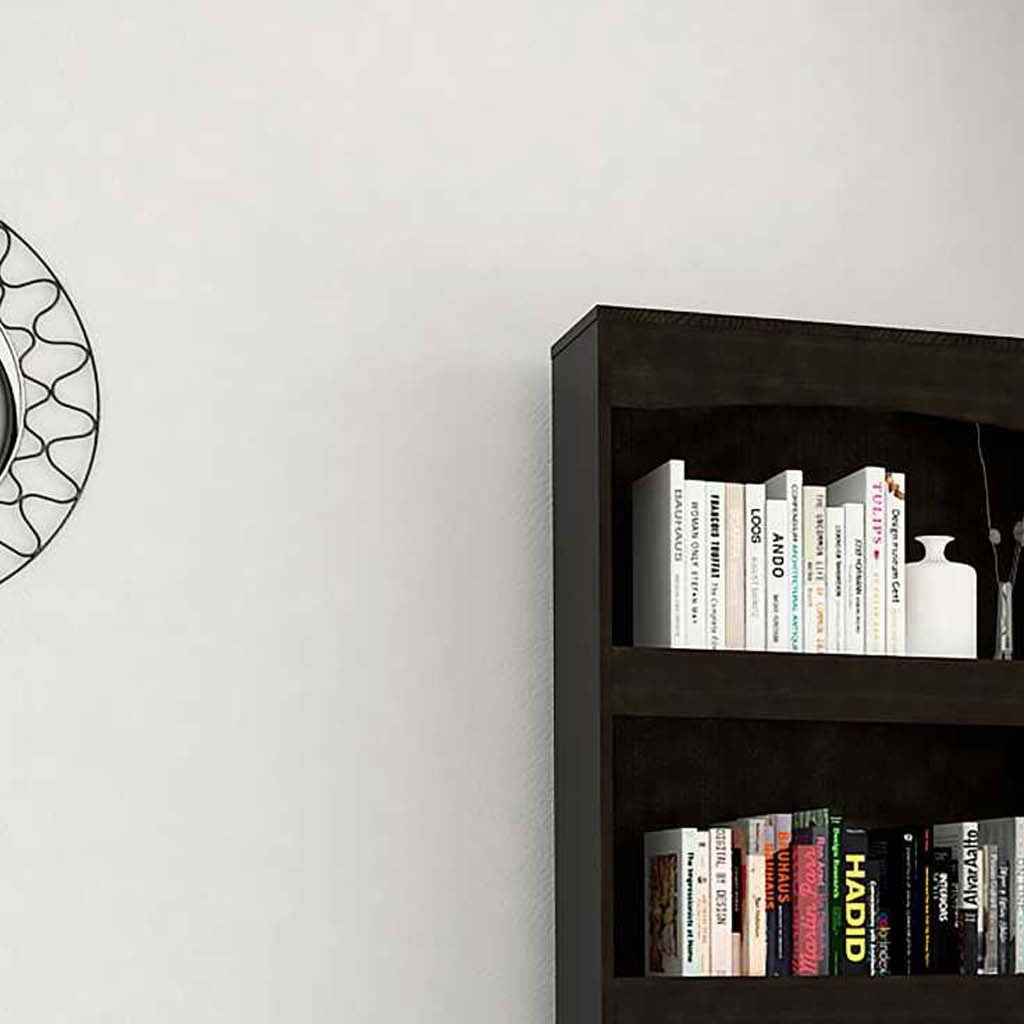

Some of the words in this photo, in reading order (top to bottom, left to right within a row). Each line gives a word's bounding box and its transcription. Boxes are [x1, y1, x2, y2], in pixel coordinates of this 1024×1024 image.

[674, 489, 684, 562] BAUHAUS
[691, 502, 700, 539] WOMAN
[751, 508, 762, 544] LOOS
[871, 483, 882, 545] TULIPS
[889, 509, 901, 541] Design
[690, 541, 700, 567] ONLY
[772, 532, 785, 579] ANDO
[686, 852, 695, 867] The
[715, 830, 728, 868] DIGITAL
[777, 831, 791, 903] BAUHAUS
[716, 872, 727, 885] BY
[715, 889, 727, 926] DESIGN
[845, 854, 866, 963] HADID
